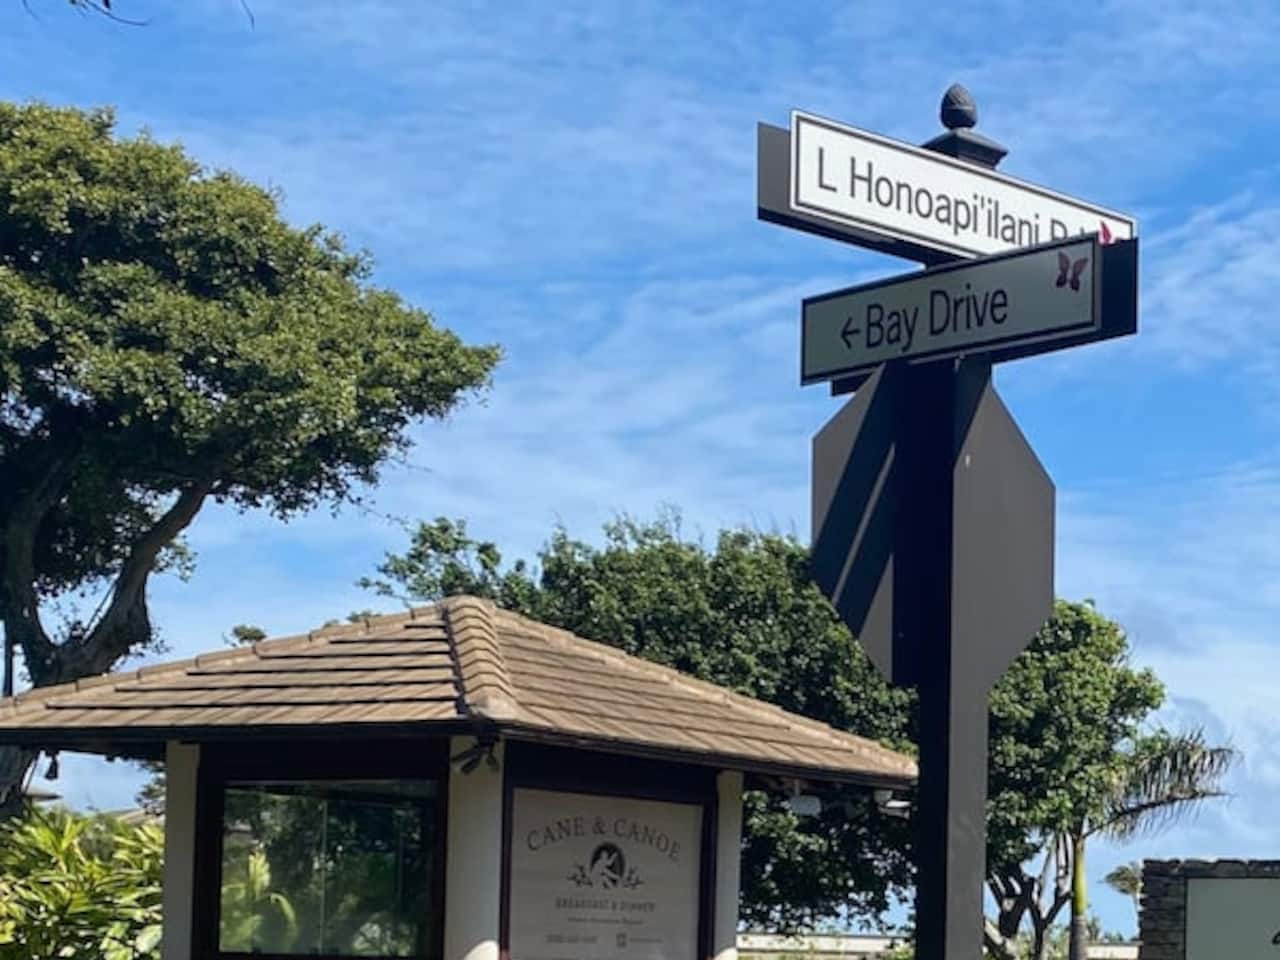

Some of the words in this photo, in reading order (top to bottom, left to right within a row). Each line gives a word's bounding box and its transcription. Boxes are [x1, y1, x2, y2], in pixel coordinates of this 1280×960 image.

[818, 146, 837, 193] L
[866, 303, 918, 352] Bay
[929, 283, 1008, 337] Drive
[527, 816, 584, 851] CANE
[592, 815, 606, 836] &
[613, 817, 681, 862] CANOE
